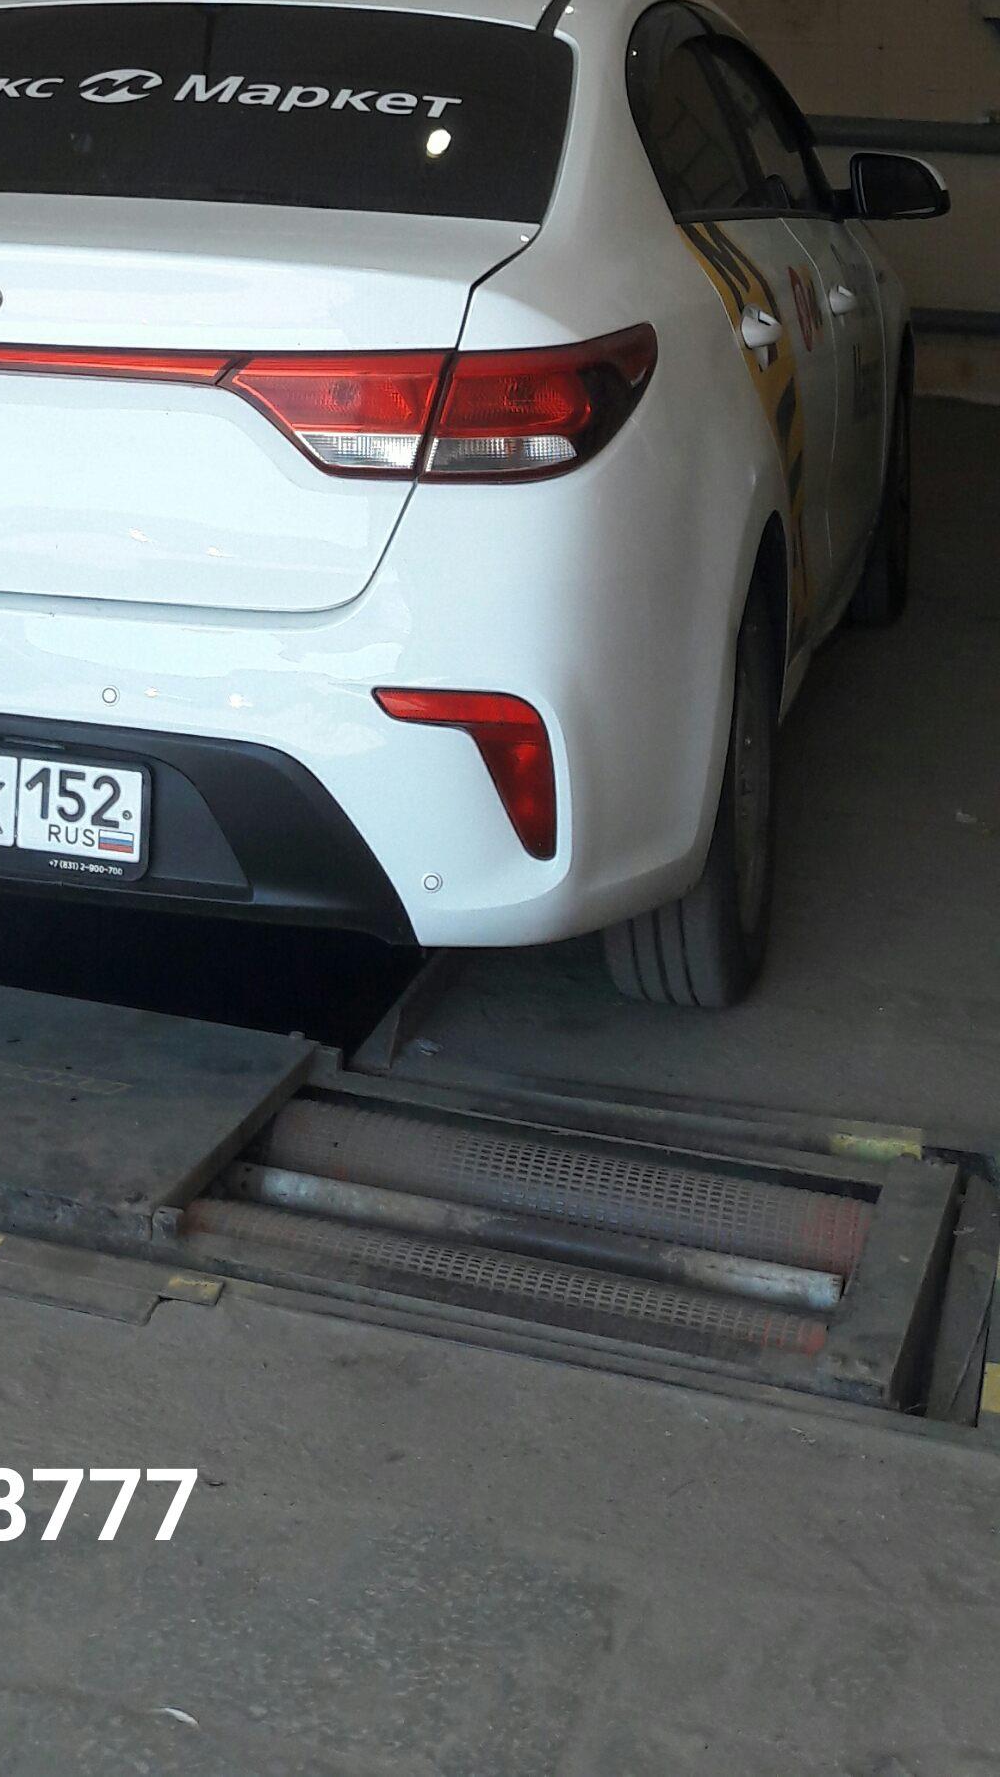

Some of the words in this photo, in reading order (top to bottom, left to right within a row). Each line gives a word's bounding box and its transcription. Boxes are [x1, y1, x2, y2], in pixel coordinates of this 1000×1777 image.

[174, 74, 463, 119] Маркет
[25, 767, 122, 829] 152
[48, 824, 96, 848] RUS
